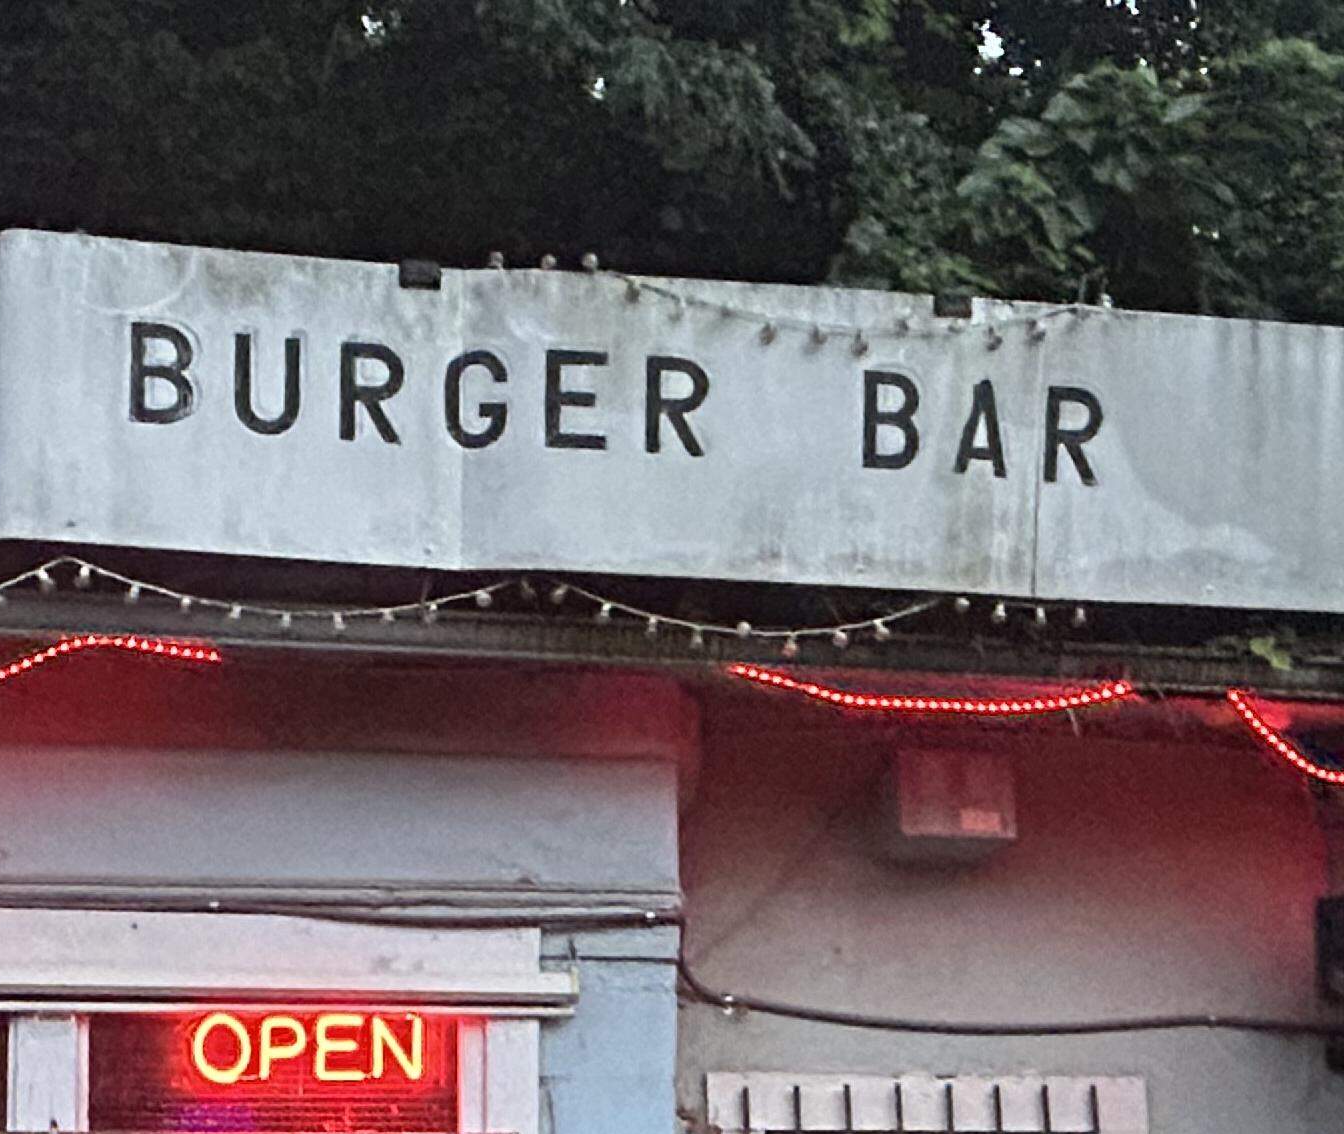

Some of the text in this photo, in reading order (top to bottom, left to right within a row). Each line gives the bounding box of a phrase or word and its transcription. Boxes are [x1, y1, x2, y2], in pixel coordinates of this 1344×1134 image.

[128, 320, 1106, 488] BURGER BAR
[191, 1011, 424, 1085] OPEN
